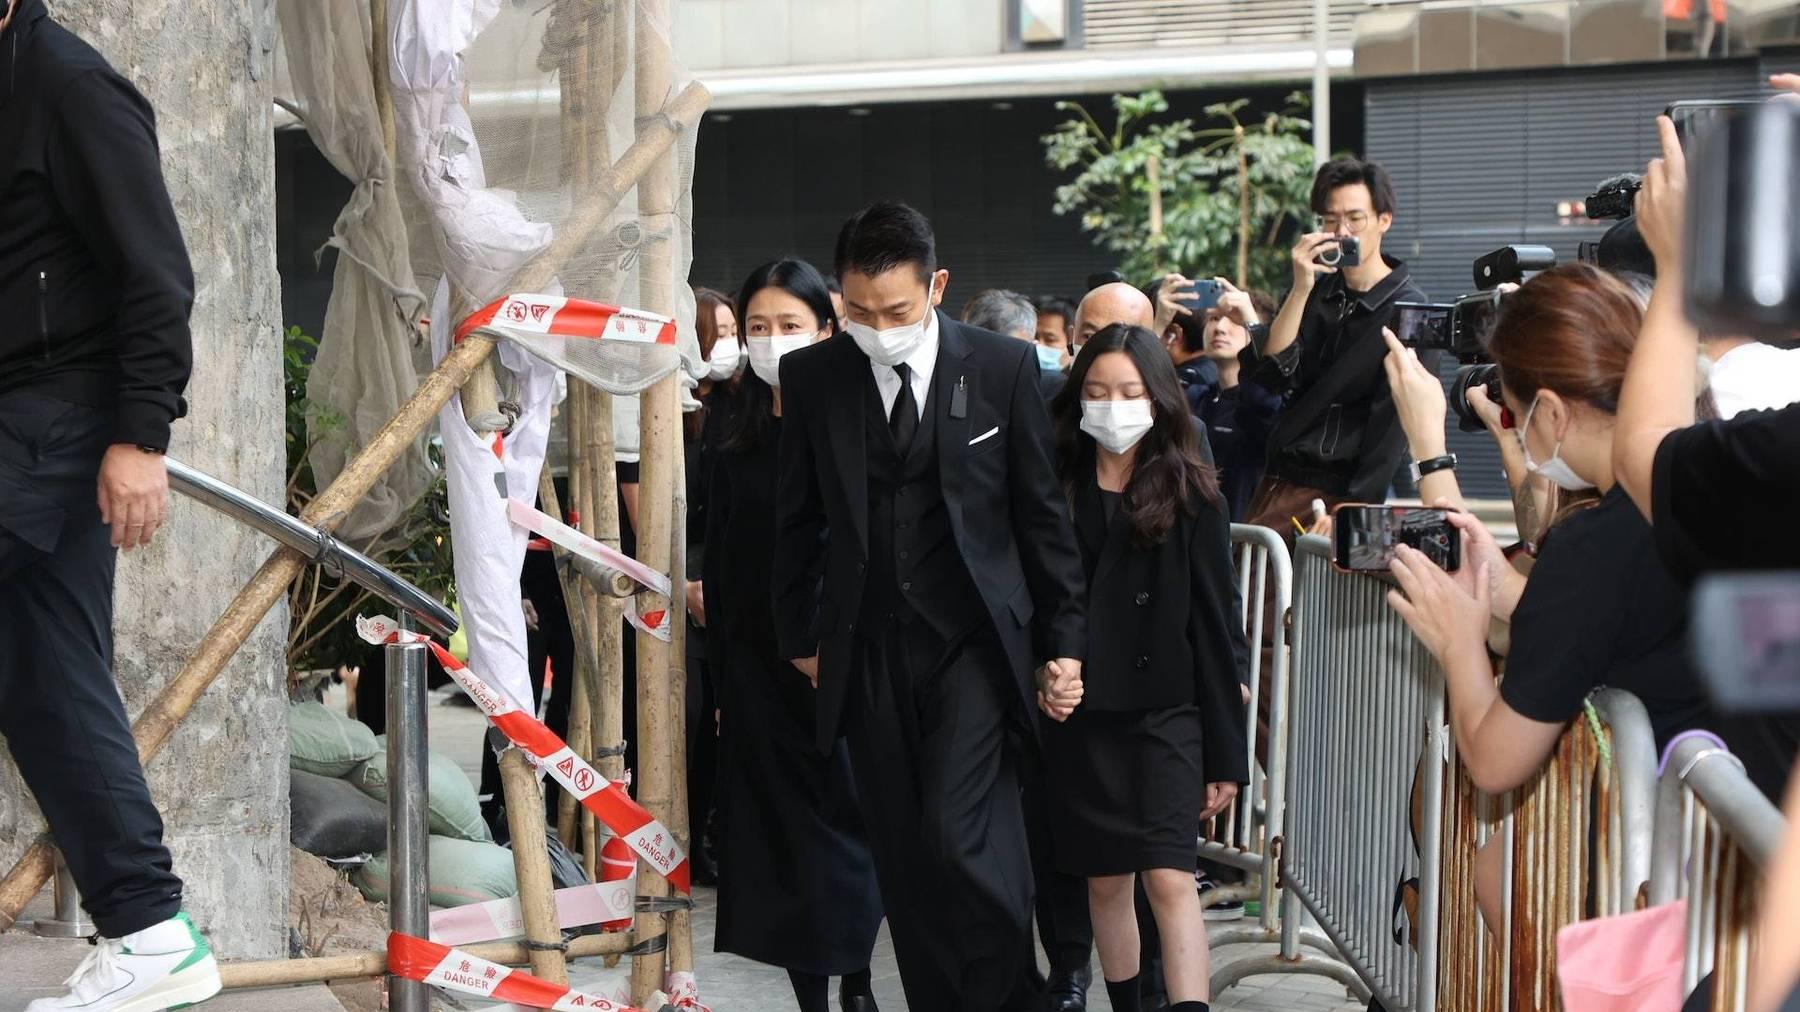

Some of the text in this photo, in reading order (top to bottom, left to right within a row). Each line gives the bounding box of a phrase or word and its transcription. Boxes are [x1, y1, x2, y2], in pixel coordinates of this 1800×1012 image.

[460, 677, 498, 713] DANGER
[638, 837, 670, 870] DANGER
[443, 970, 489, 991] DANGER
[458, 959, 498, 981] 危險
